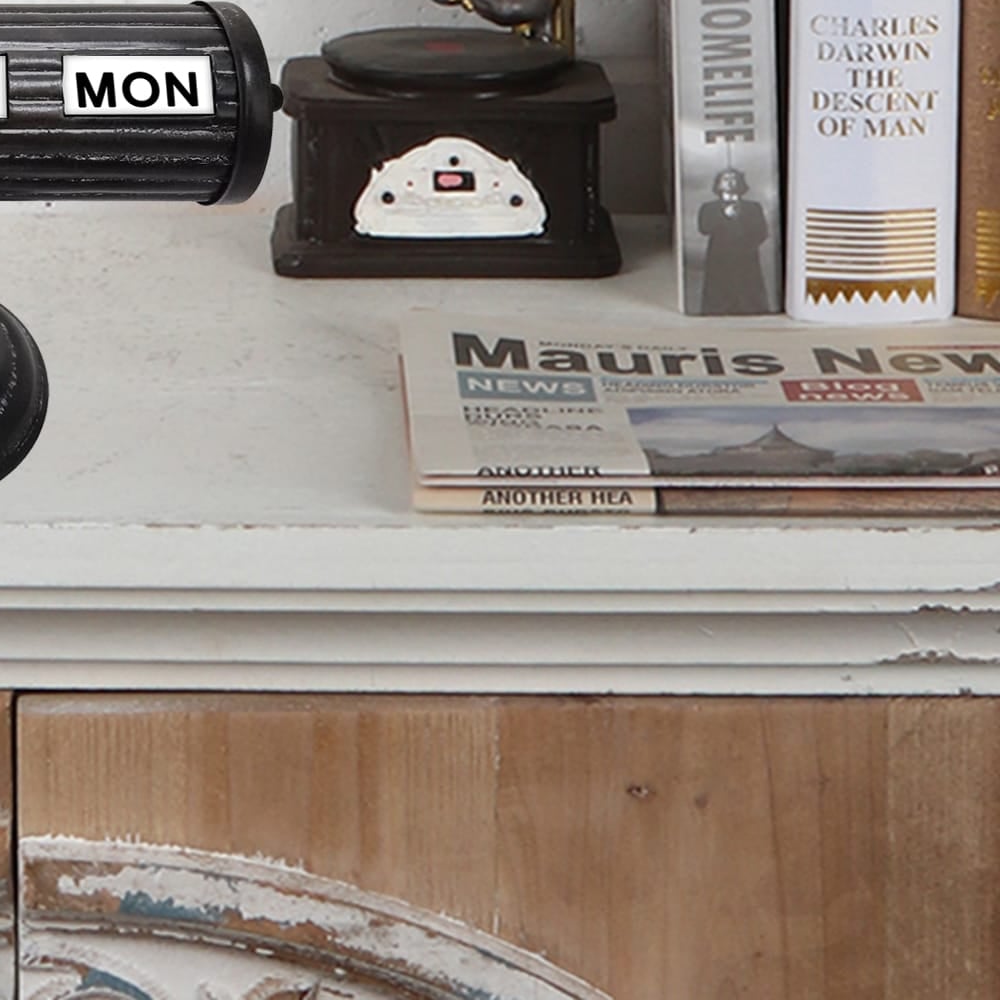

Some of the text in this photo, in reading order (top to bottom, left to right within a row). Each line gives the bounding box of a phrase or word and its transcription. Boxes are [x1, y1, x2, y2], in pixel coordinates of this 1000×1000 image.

[810, 14, 939, 38] CHARLES
[818, 41, 932, 62] DARWIN
[846, 68, 903, 88] THE
[76, 71, 200, 108] MON
[812, 90, 939, 113] DESCENT
[818, 116, 926, 138] OF MAN
[452, 332, 785, 376] Mauris
[466, 377, 587, 396] NEWS
[799, 391, 910, 401] news
[801, 381, 900, 393] Blog
[477, 465, 601, 477] ANOTHER
[482, 489, 583, 505] ANOTHER
